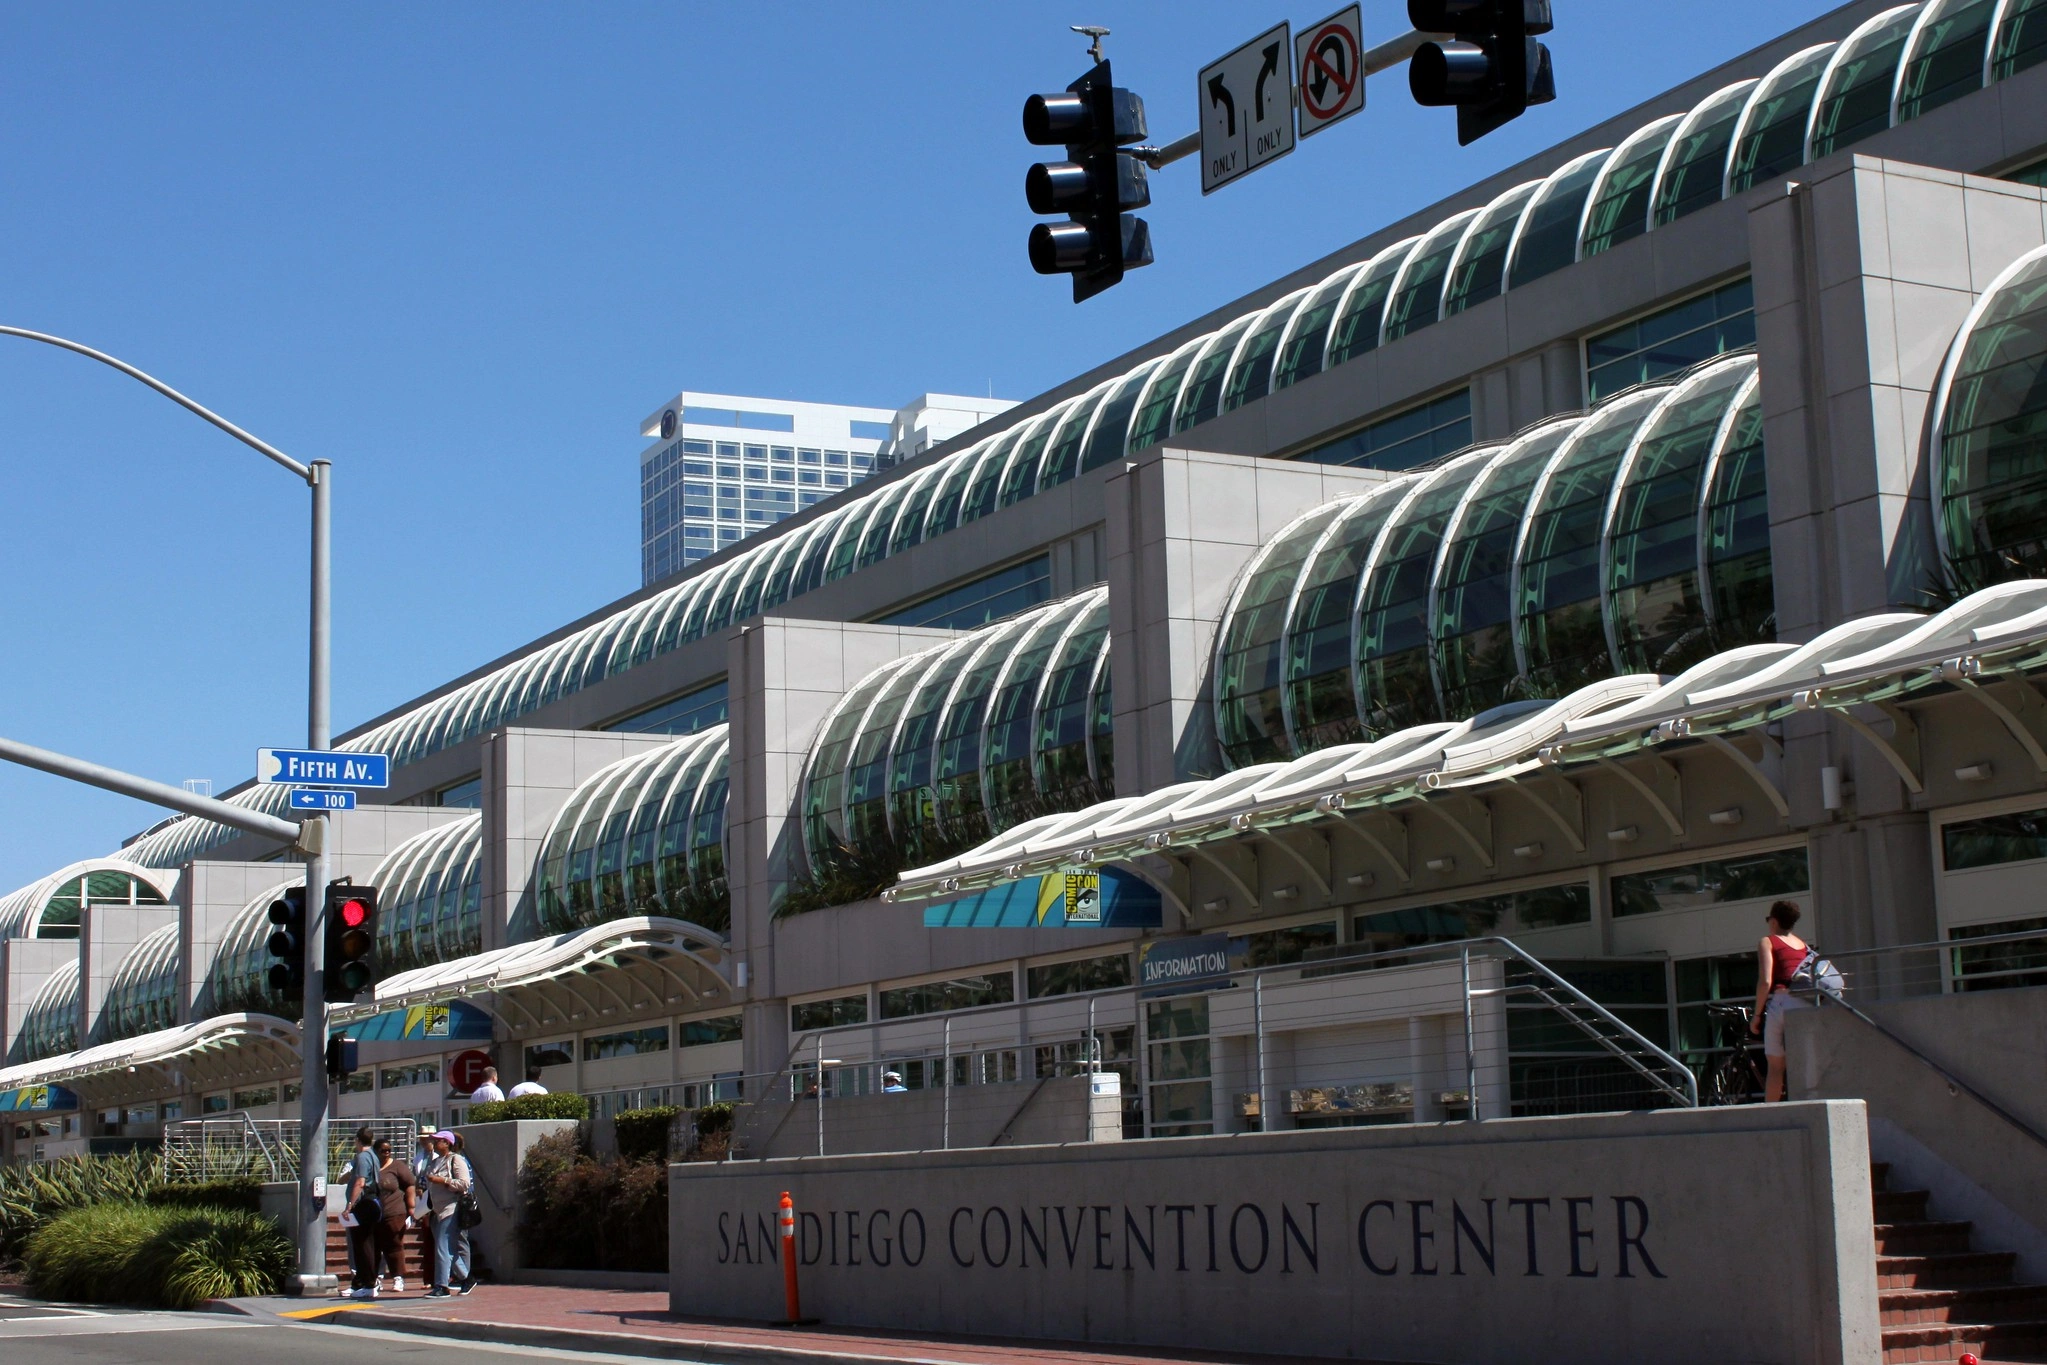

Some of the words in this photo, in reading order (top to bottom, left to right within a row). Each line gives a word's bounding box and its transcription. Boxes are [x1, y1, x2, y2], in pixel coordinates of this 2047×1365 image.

[1257, 127, 1282, 156] ONLY
[1213, 151, 1237, 178] ONLY
[324, 794, 346, 808] 100
[1066, 875, 1077, 913] COMIC
[1077, 875, 1098, 888] CON
[1145, 951, 1226, 981] INFORMATION
[465, 1059, 482, 1085] F
[717, 1211, 778, 1265] SAN
[798, 1208, 927, 1268] DIEGO
[948, 1202, 1321, 1275] CONVENTION
[1357, 1195, 1669, 1279] CENTER
